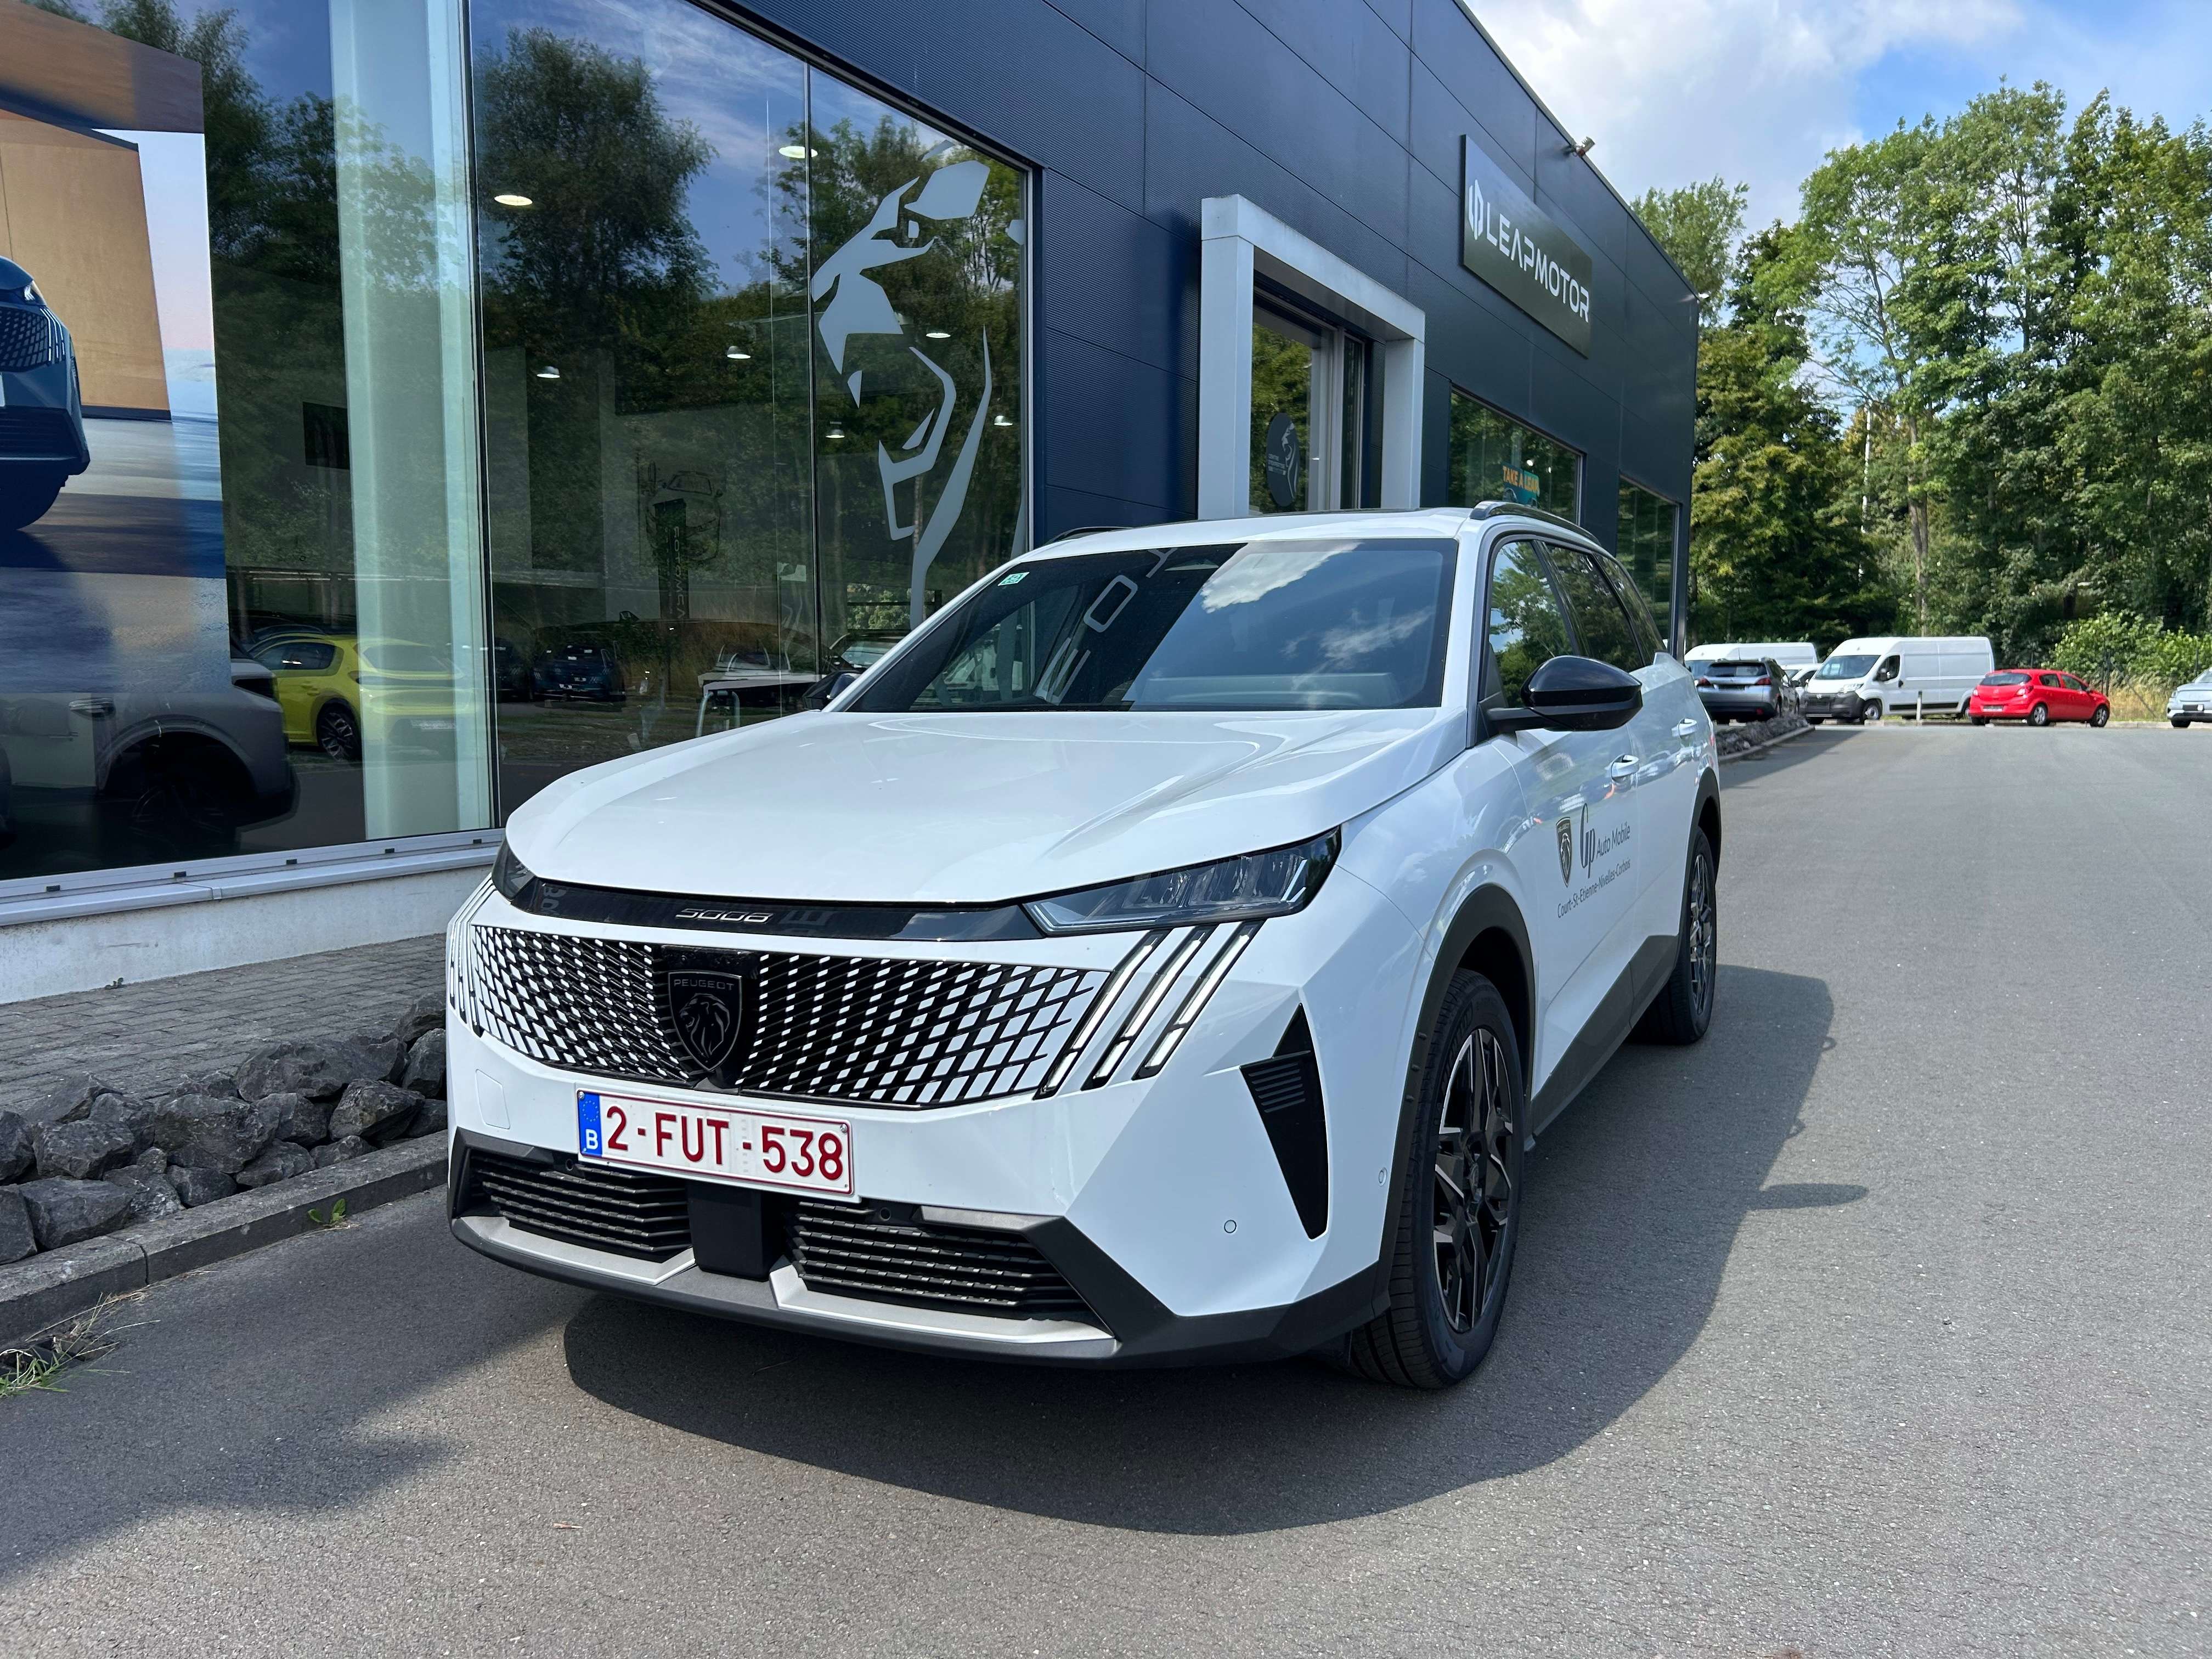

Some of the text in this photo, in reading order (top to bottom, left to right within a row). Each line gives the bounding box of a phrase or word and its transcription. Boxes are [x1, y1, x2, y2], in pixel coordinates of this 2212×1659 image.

[1487, 201, 1589, 323] LEAPMOTOR
[1596, 821, 1630, 860] Auto Mobile
[675, 908, 774, 924] 5008
[674, 979, 735, 991] PEUGEOT
[585, 1128, 599, 1150] B
[606, 1105, 844, 1181] 2-FUT-538
